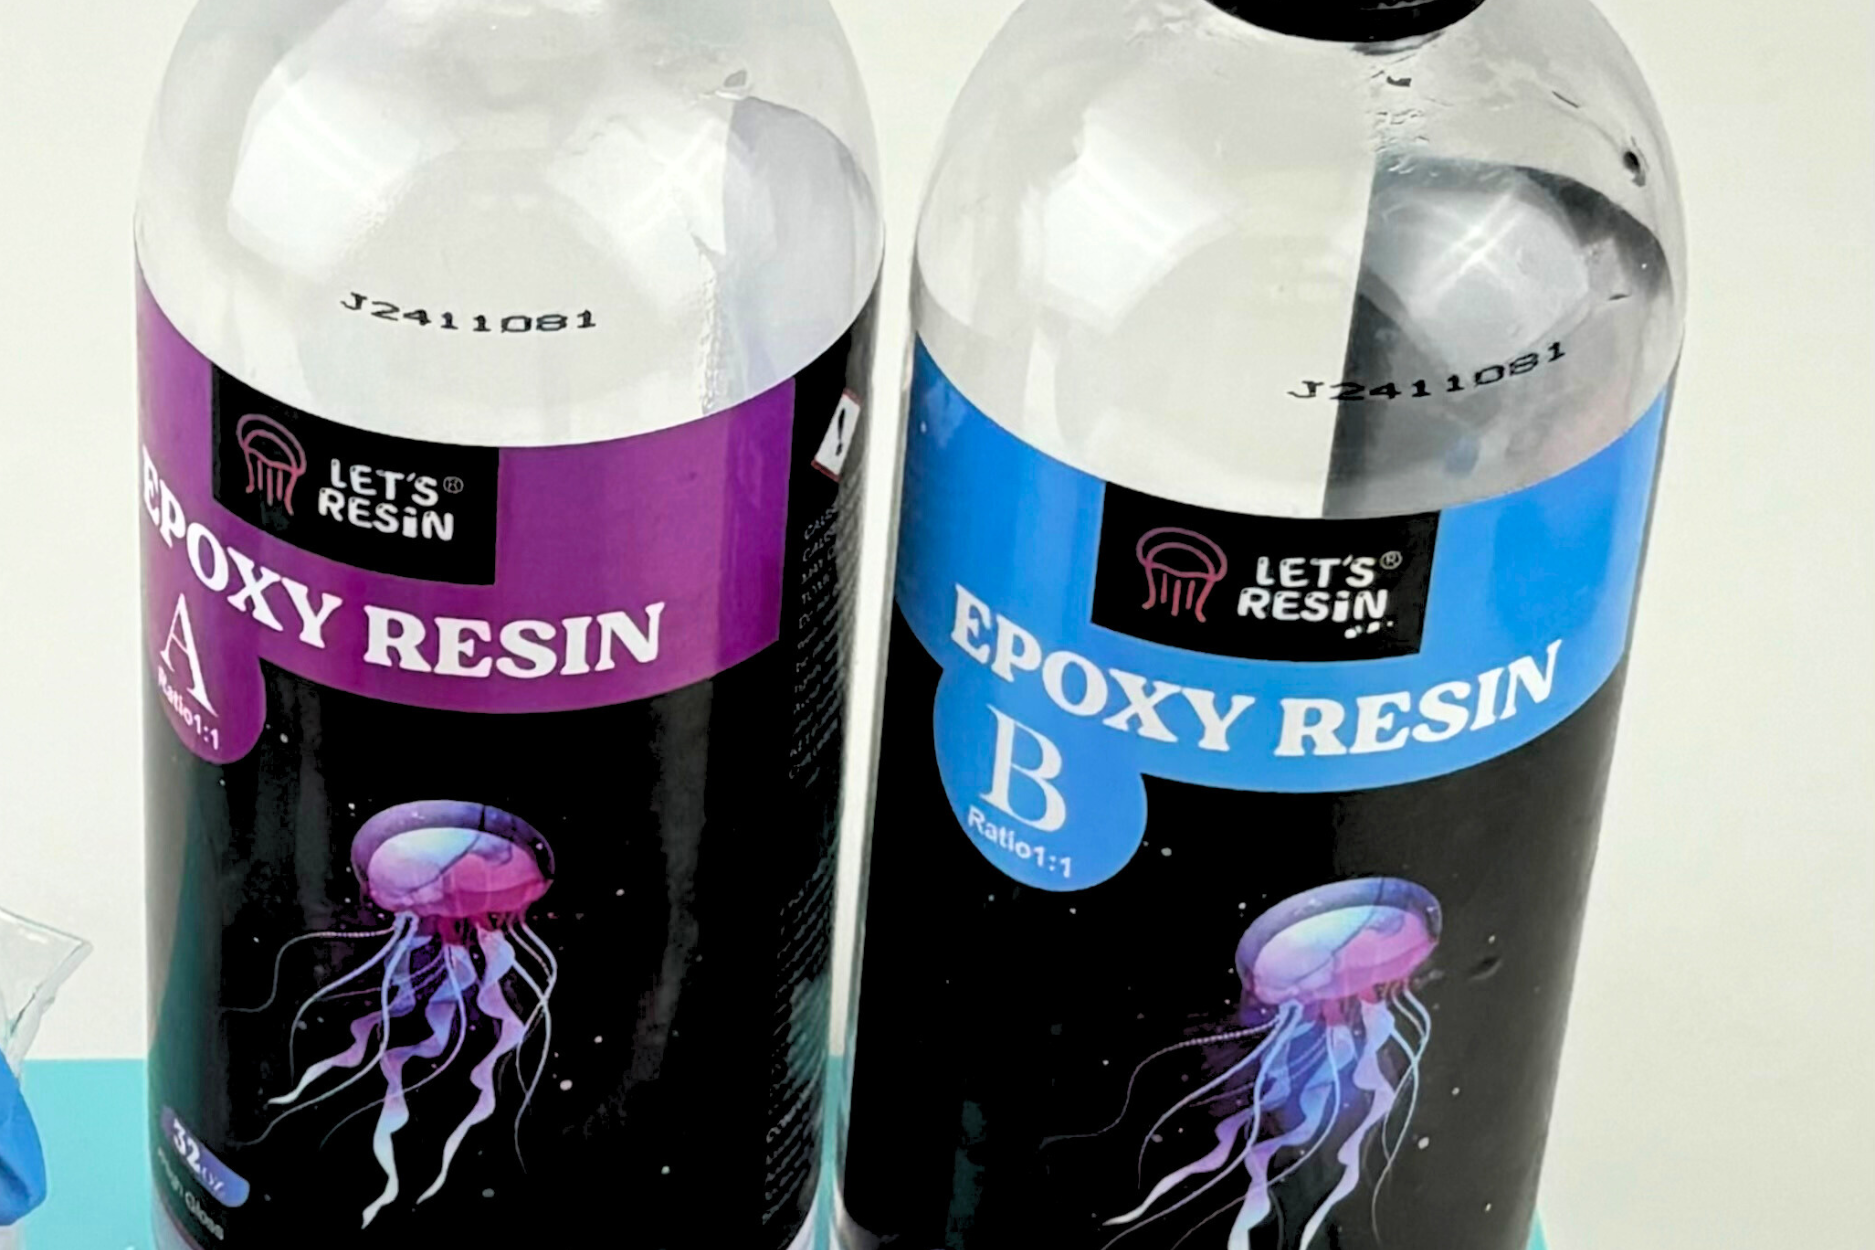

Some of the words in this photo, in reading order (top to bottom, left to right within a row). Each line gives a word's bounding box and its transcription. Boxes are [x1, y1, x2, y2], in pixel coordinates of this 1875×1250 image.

[340, 291, 596, 333] J2411081
[1287, 341, 1565, 401] J2411081
[142, 445, 344, 649] EPOXY
[363, 602, 665, 679] RESIN
[159, 592, 219, 718] A
[953, 583, 1256, 755] EPOXY
[1274, 638, 1563, 757] RESIN
[979, 703, 1067, 833] B
[967, 804, 1071, 879] Ratio1:1
